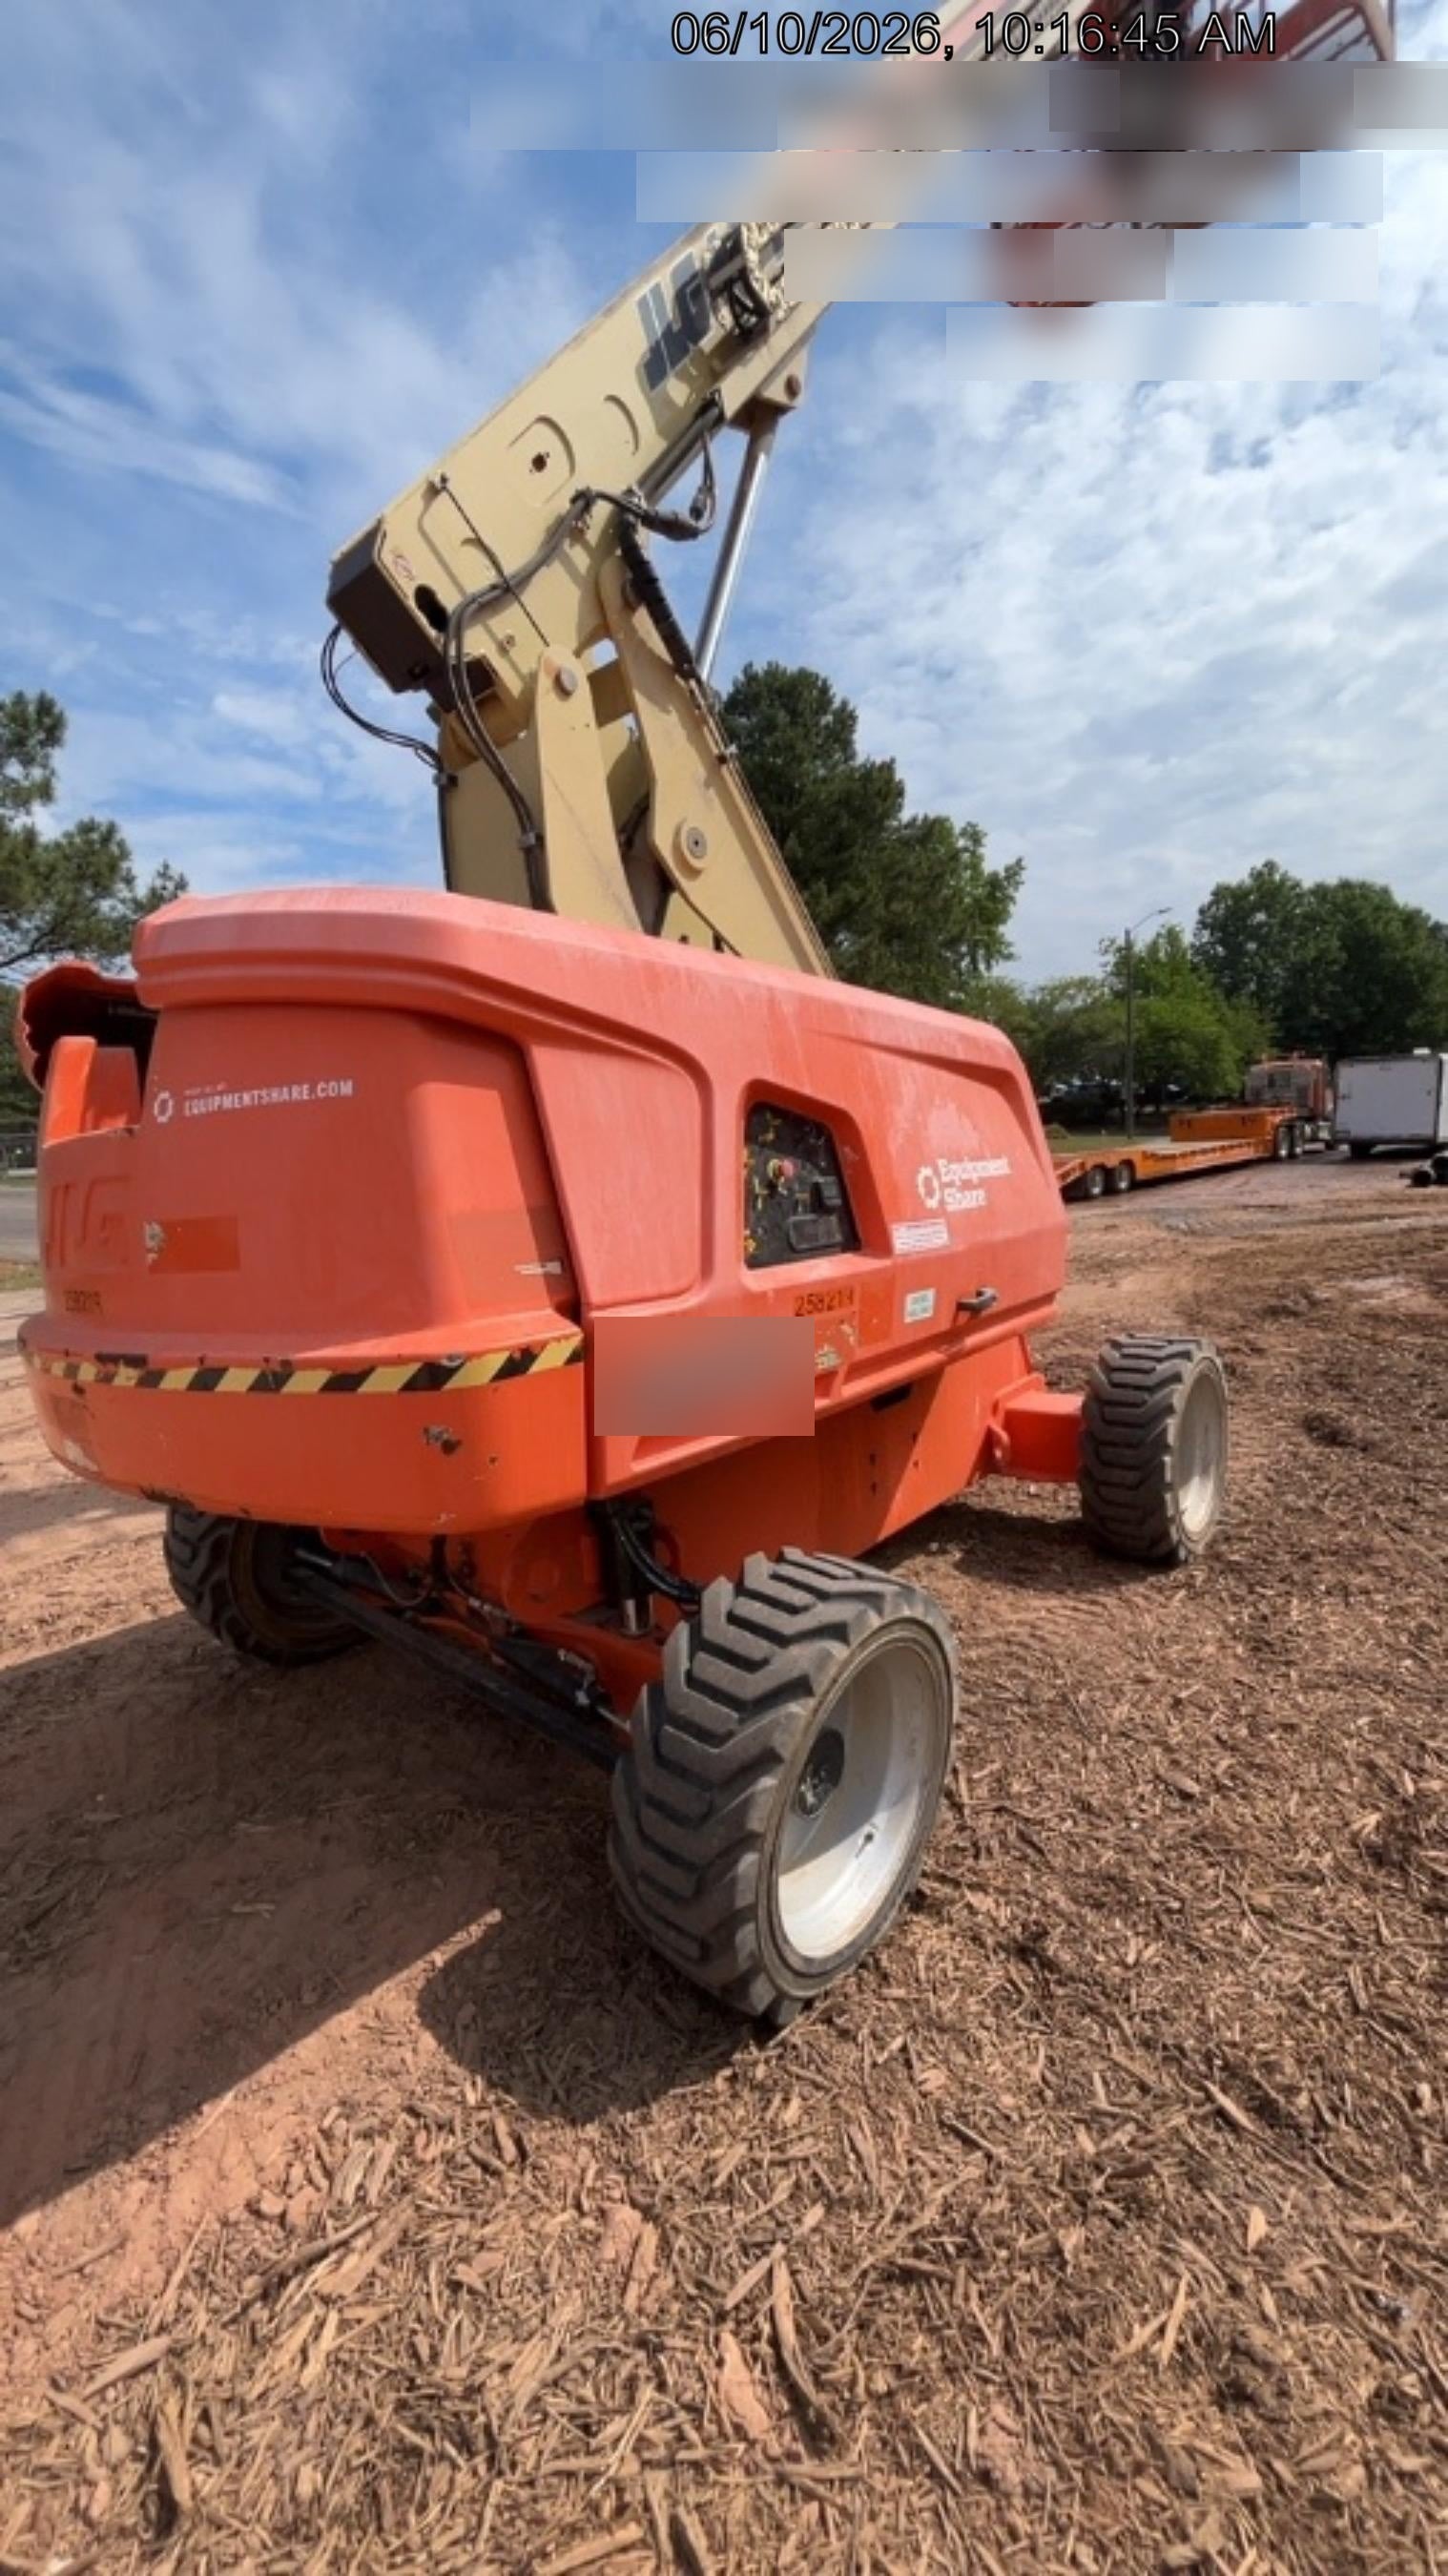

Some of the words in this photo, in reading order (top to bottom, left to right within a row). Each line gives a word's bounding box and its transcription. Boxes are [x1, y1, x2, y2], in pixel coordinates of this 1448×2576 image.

[184, 1079, 354, 1117] EQUIPMENTSHARE.COM
[938, 1155, 1011, 1186] Equipment
[943, 1187, 987, 1212] Share
